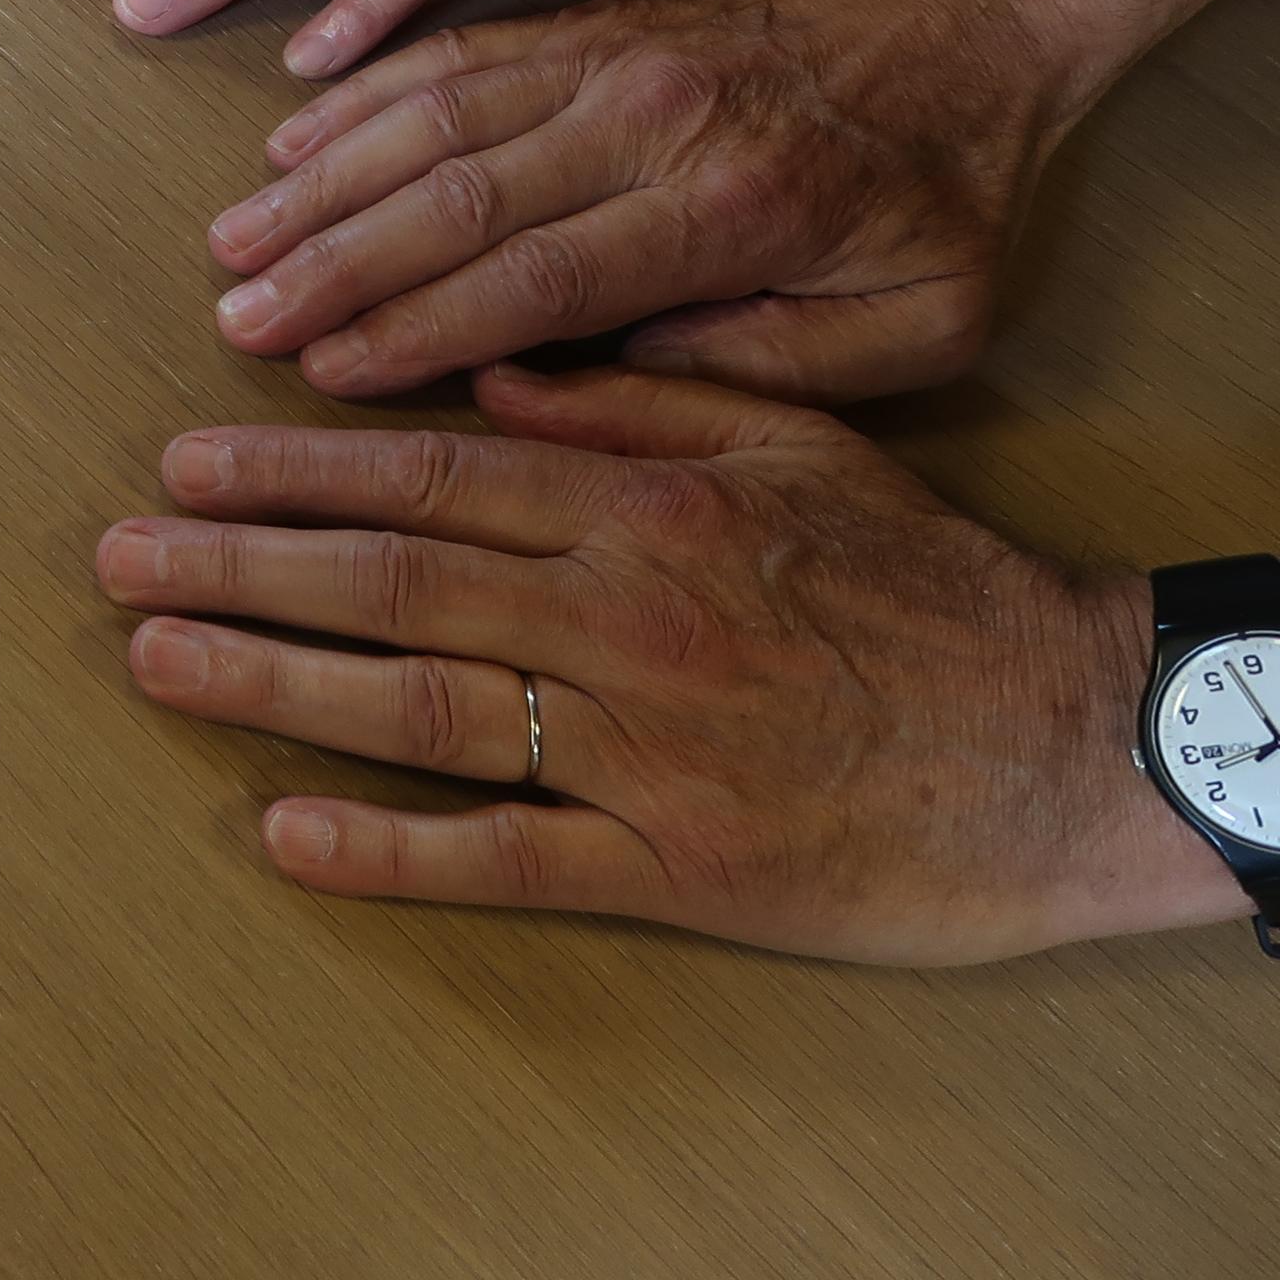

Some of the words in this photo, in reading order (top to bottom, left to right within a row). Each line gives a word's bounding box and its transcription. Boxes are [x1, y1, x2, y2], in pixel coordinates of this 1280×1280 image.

[1243, 654, 1264, 675] 6
[1203, 671, 1225, 692] 5
[1179, 705, 1199, 725] 4
[1180, 744, 1201, 765] 3
[1205, 780, 1227, 802] 2
[1252, 807, 1263, 828] 1
